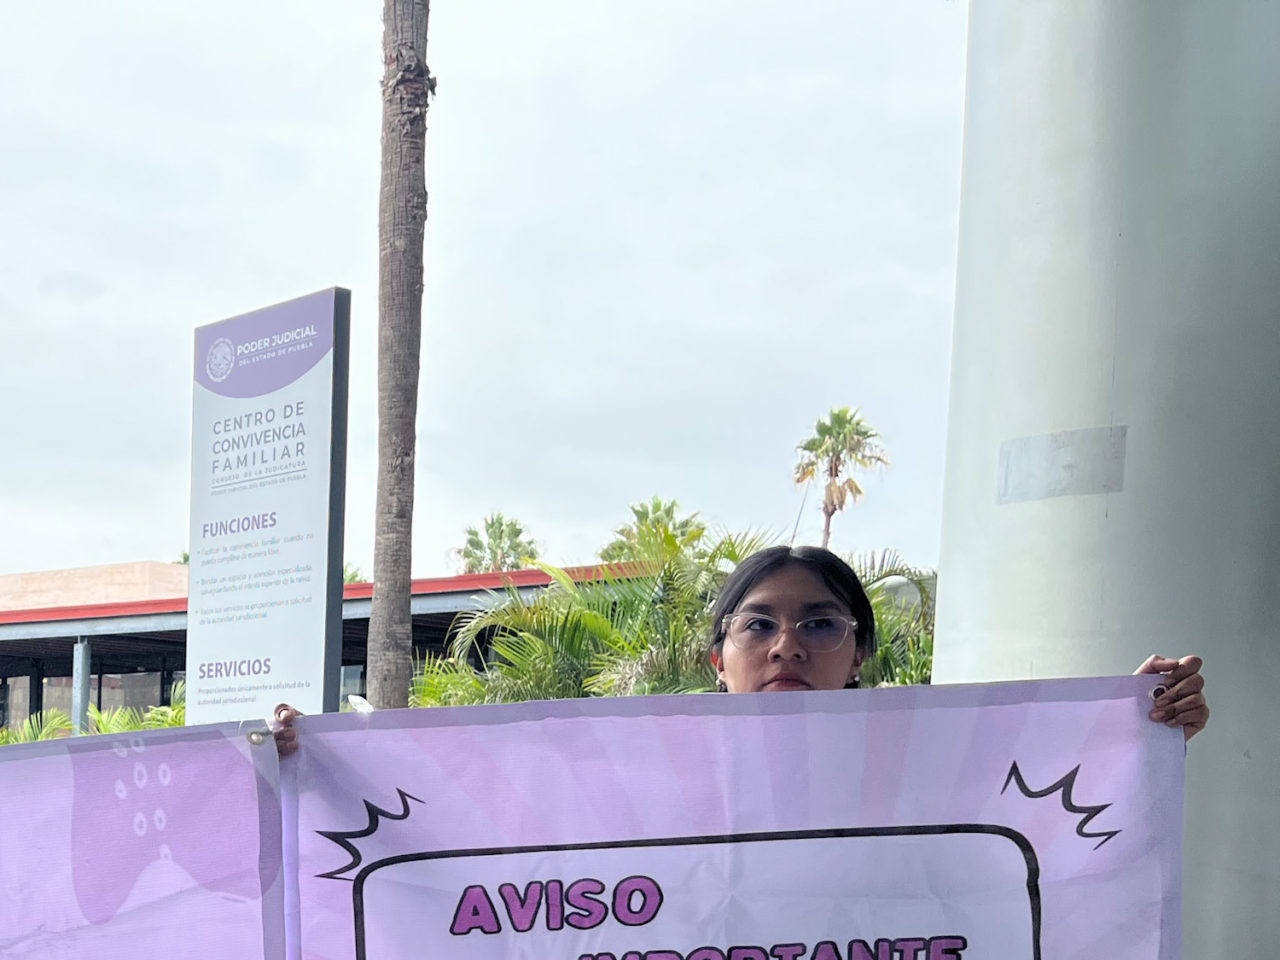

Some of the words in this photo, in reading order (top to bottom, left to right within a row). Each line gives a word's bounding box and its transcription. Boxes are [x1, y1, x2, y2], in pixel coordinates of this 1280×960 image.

[236, 337, 270, 356] PODER
[271, 324, 317, 346] JUDICIAL
[252, 352, 276, 363] ESTADO
[288, 342, 313, 353] PUEBLA
[213, 408, 276, 435] CENTRO
[283, 401, 305, 418] DE
[212, 422, 306, 455] CONVIVENCIA
[211, 441, 306, 474] FAMILIAR
[264, 460, 306, 474] JUDICATURA
[202, 511, 278, 538] FUNCIONES
[198, 658, 272, 680] SERVICIOS
[449, 875, 664, 936] AVISO
